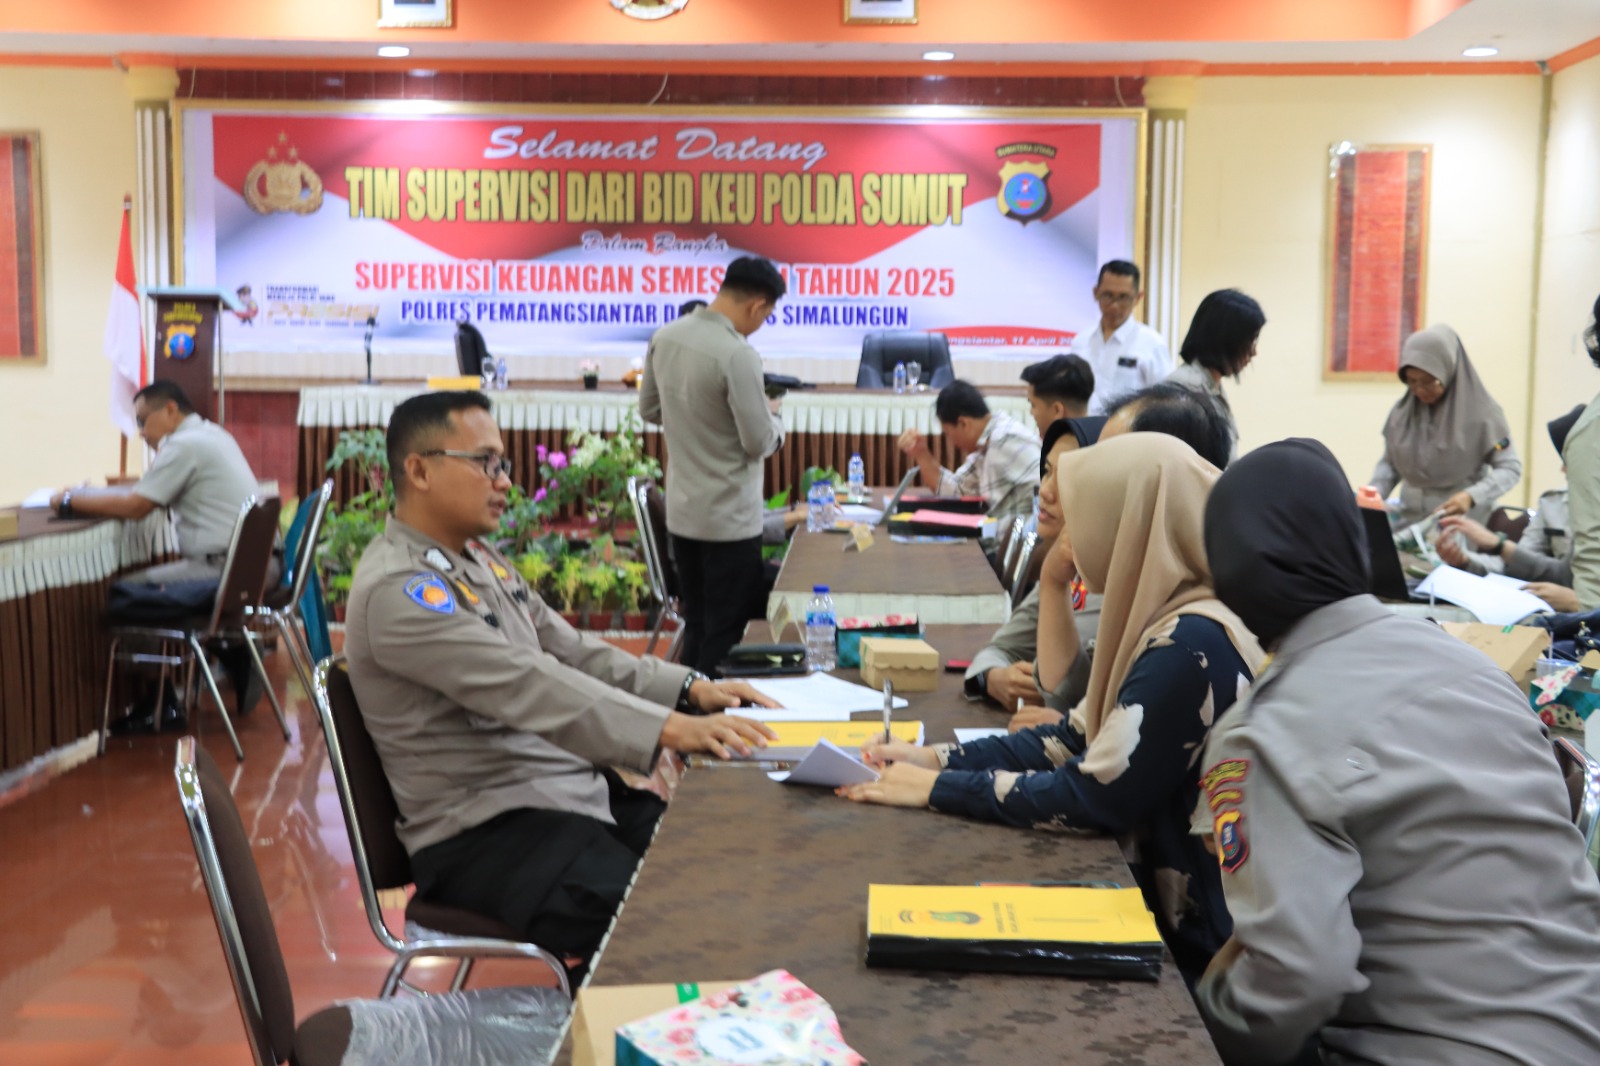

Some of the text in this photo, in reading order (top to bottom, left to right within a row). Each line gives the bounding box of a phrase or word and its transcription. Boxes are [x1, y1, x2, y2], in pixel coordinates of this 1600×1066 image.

[483, 125, 827, 171] Selamat Datang
[345, 166, 967, 227] TIM SUPERVISI DARI BID KEU POLDA SUMUT
[582, 230, 648, 251] Dalam
[355, 262, 490, 291] SUPERVISI
[499, 265, 633, 294] KEUANGAN
[641, 265, 725, 295] SEMES
[795, 268, 879, 296] TAHUN
[887, 268, 955, 297] 2025
[401, 300, 471, 321] POLRES
[477, 302, 657, 324] PEMATANGSIANTAR
[783, 305, 908, 327] SIMALUNGUN
